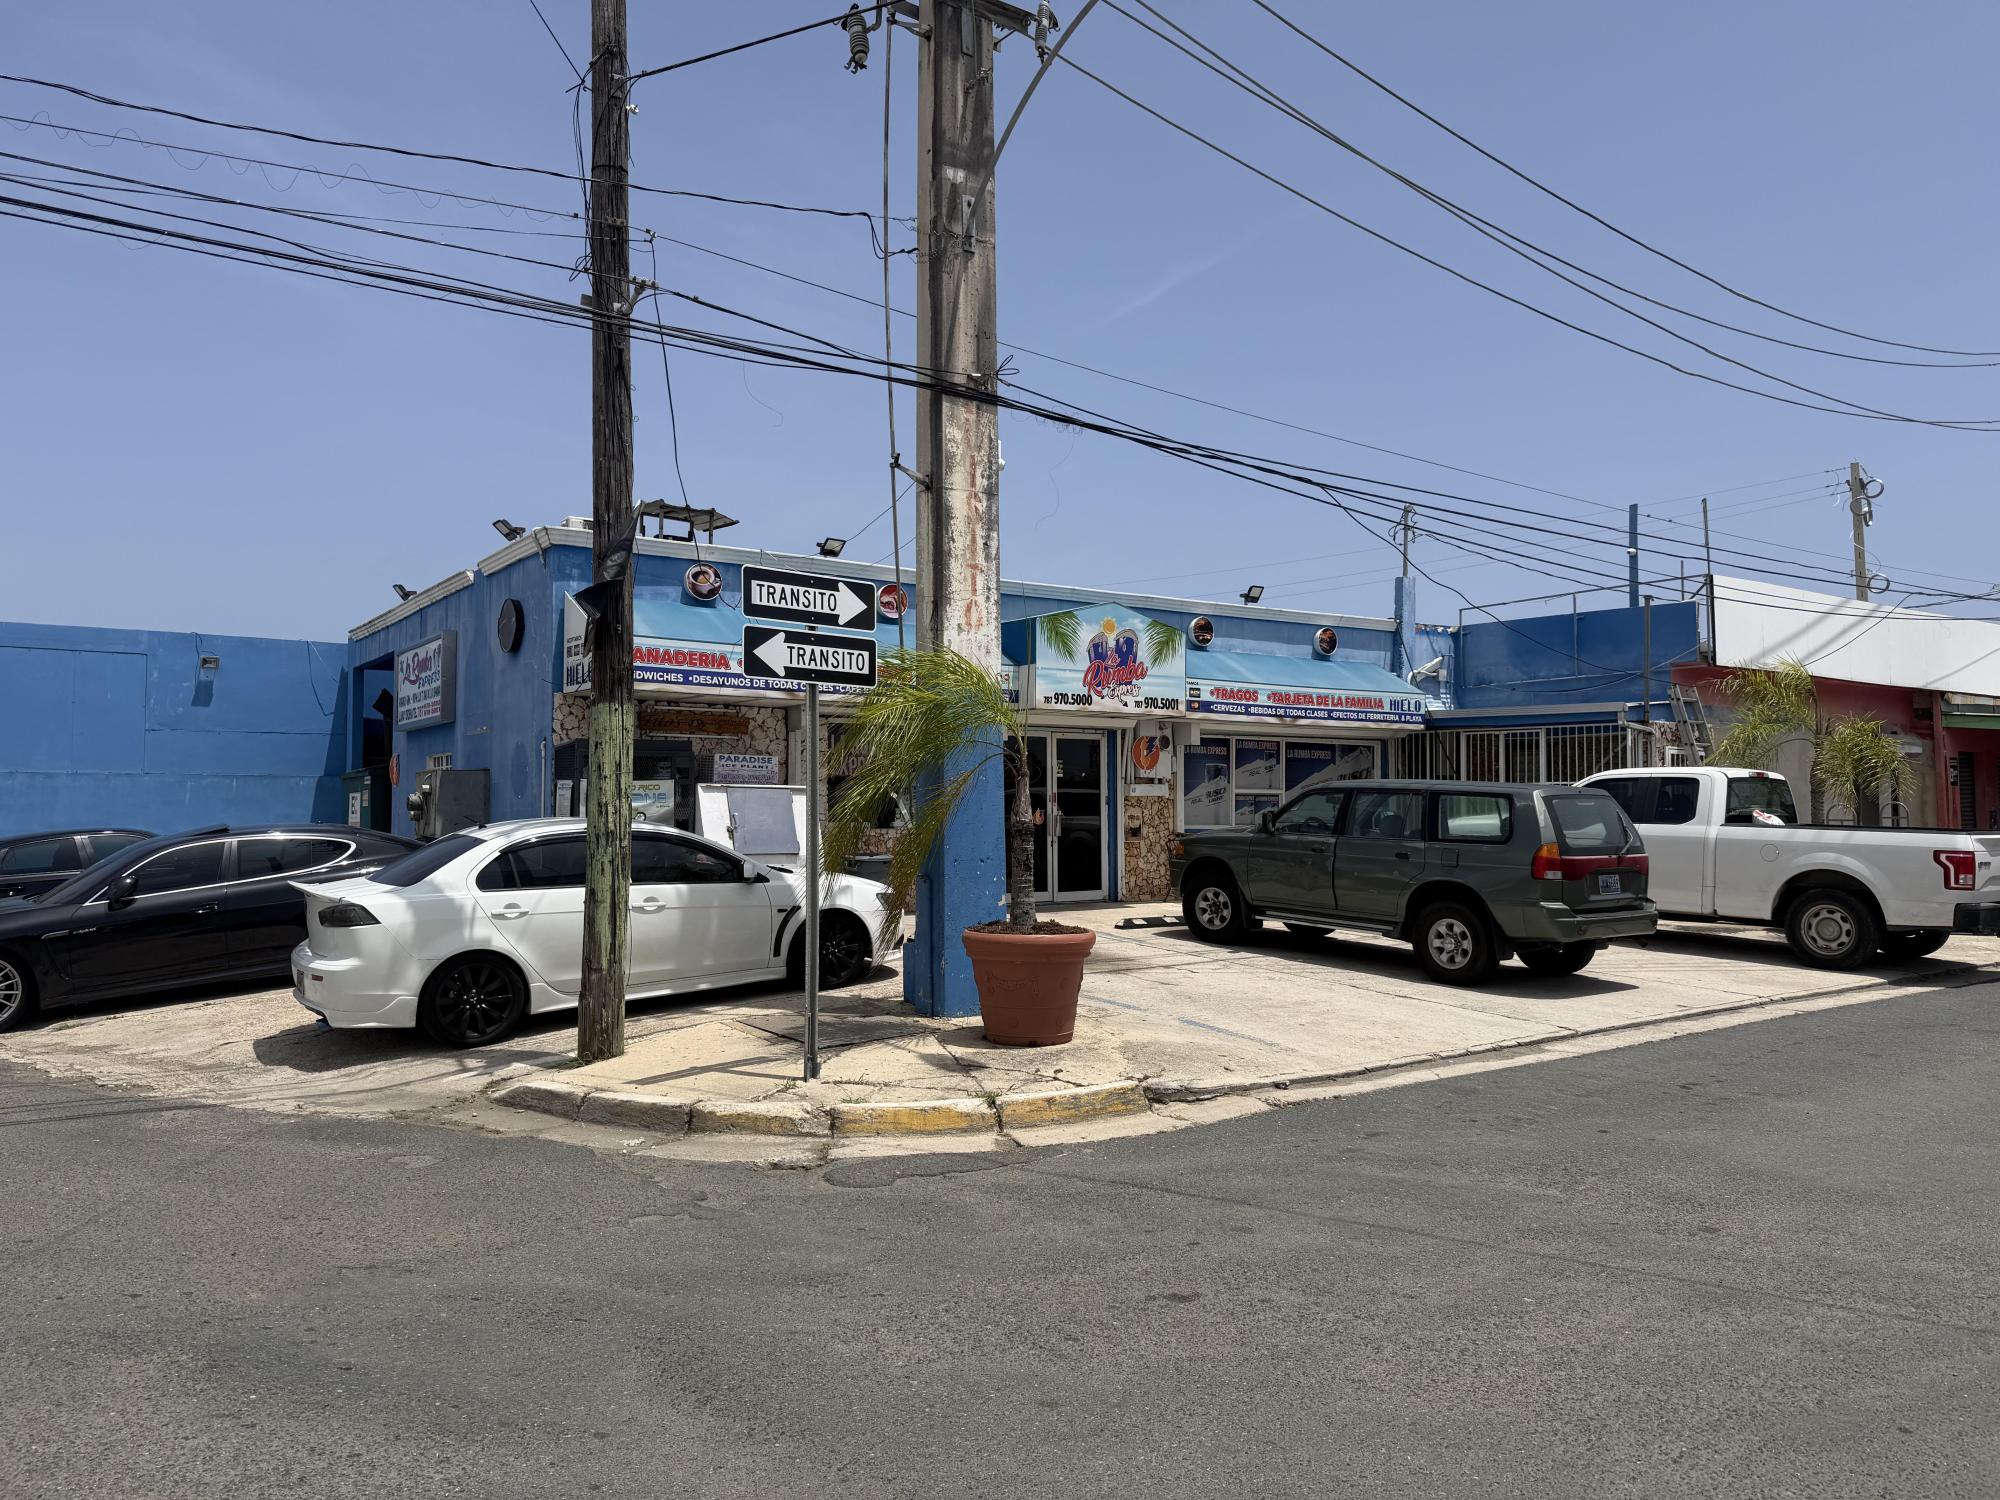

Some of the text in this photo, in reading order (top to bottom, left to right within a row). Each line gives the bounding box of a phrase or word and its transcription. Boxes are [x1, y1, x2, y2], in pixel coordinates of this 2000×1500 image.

[756, 583, 837, 612] TRANSITO
[633, 645, 731, 670] ANADERIA
[786, 645, 865, 671] TRANSITO
[1104, 647, 1121, 669] La
[634, 670, 684, 683] DWICHES
[692, 674, 751, 687] DESAYUNOS
[753, 679, 766, 688] DE
[767, 680, 798, 690] TODAS
[800, 681, 834, 692] CSES
[1083, 655, 1149, 699] Rumba
[1043, 692, 1093, 706] 787 970.5000
[1107, 680, 1142, 701] Express
[1214, 686, 1259, 703] TRAGOS
[1134, 696, 1179, 711] 787 970.5001
[1213, 703, 1246, 713] CERVEZAS
[1271, 691, 1385, 711] TARJETA DE LA FAMILIA
[1389, 698, 1422, 713] HIELO
[1250, 706, 1329, 718] BEBIDAS DE TODAS CLASES
[1333, 711, 1358, 719] EFECTOS
[1358, 712, 1367, 720] DE
[1367, 713, 1400, 721] FERRETERIA
[719, 754, 773, 765] PARADISE
